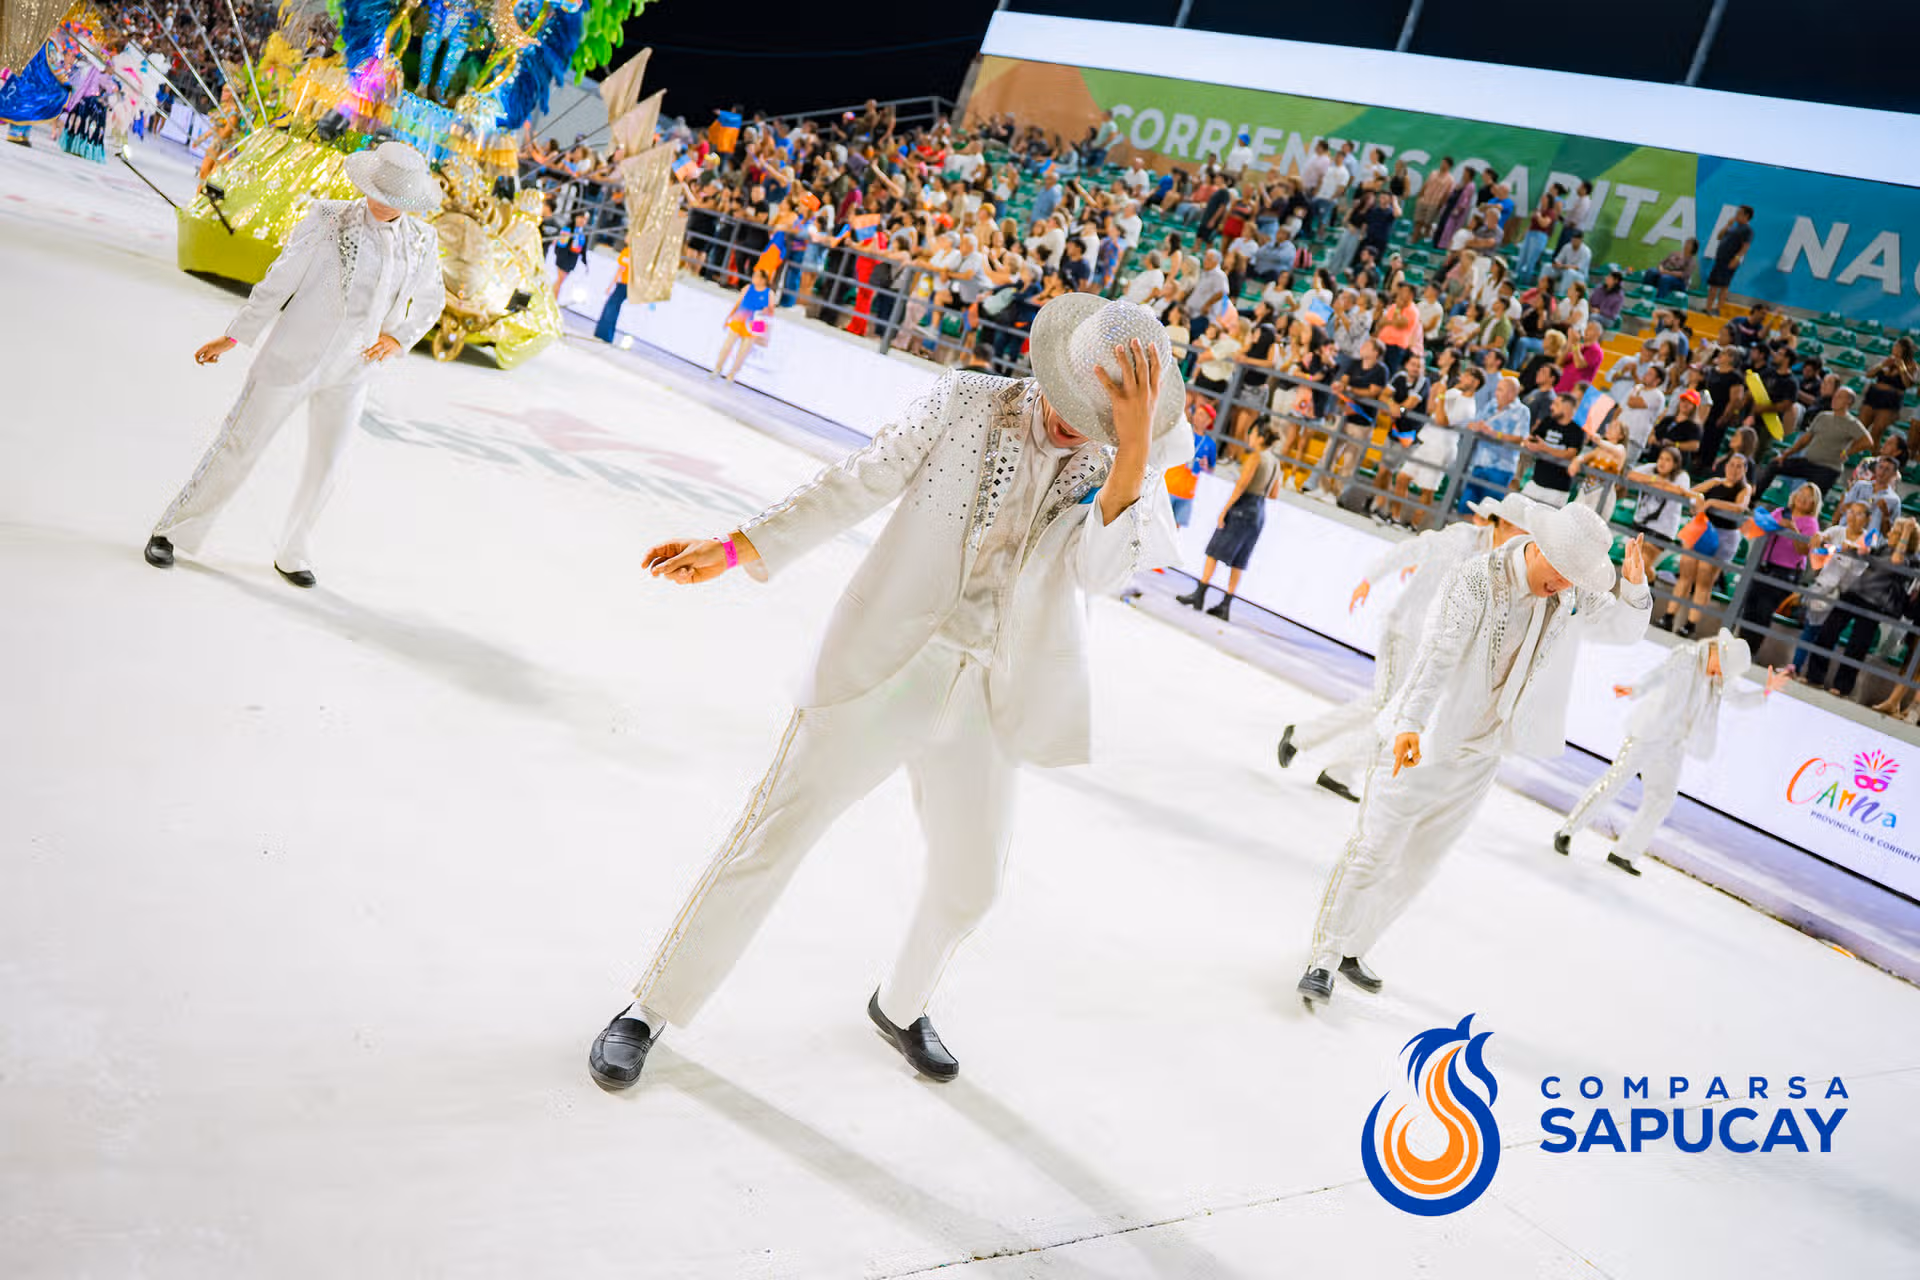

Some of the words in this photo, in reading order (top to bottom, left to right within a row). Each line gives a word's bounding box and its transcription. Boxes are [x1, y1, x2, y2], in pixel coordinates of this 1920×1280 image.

[1776, 215, 1920, 296] NA
[1810, 810, 1861, 838] PROVINCIAL
[1863, 832, 1876, 844] DE
